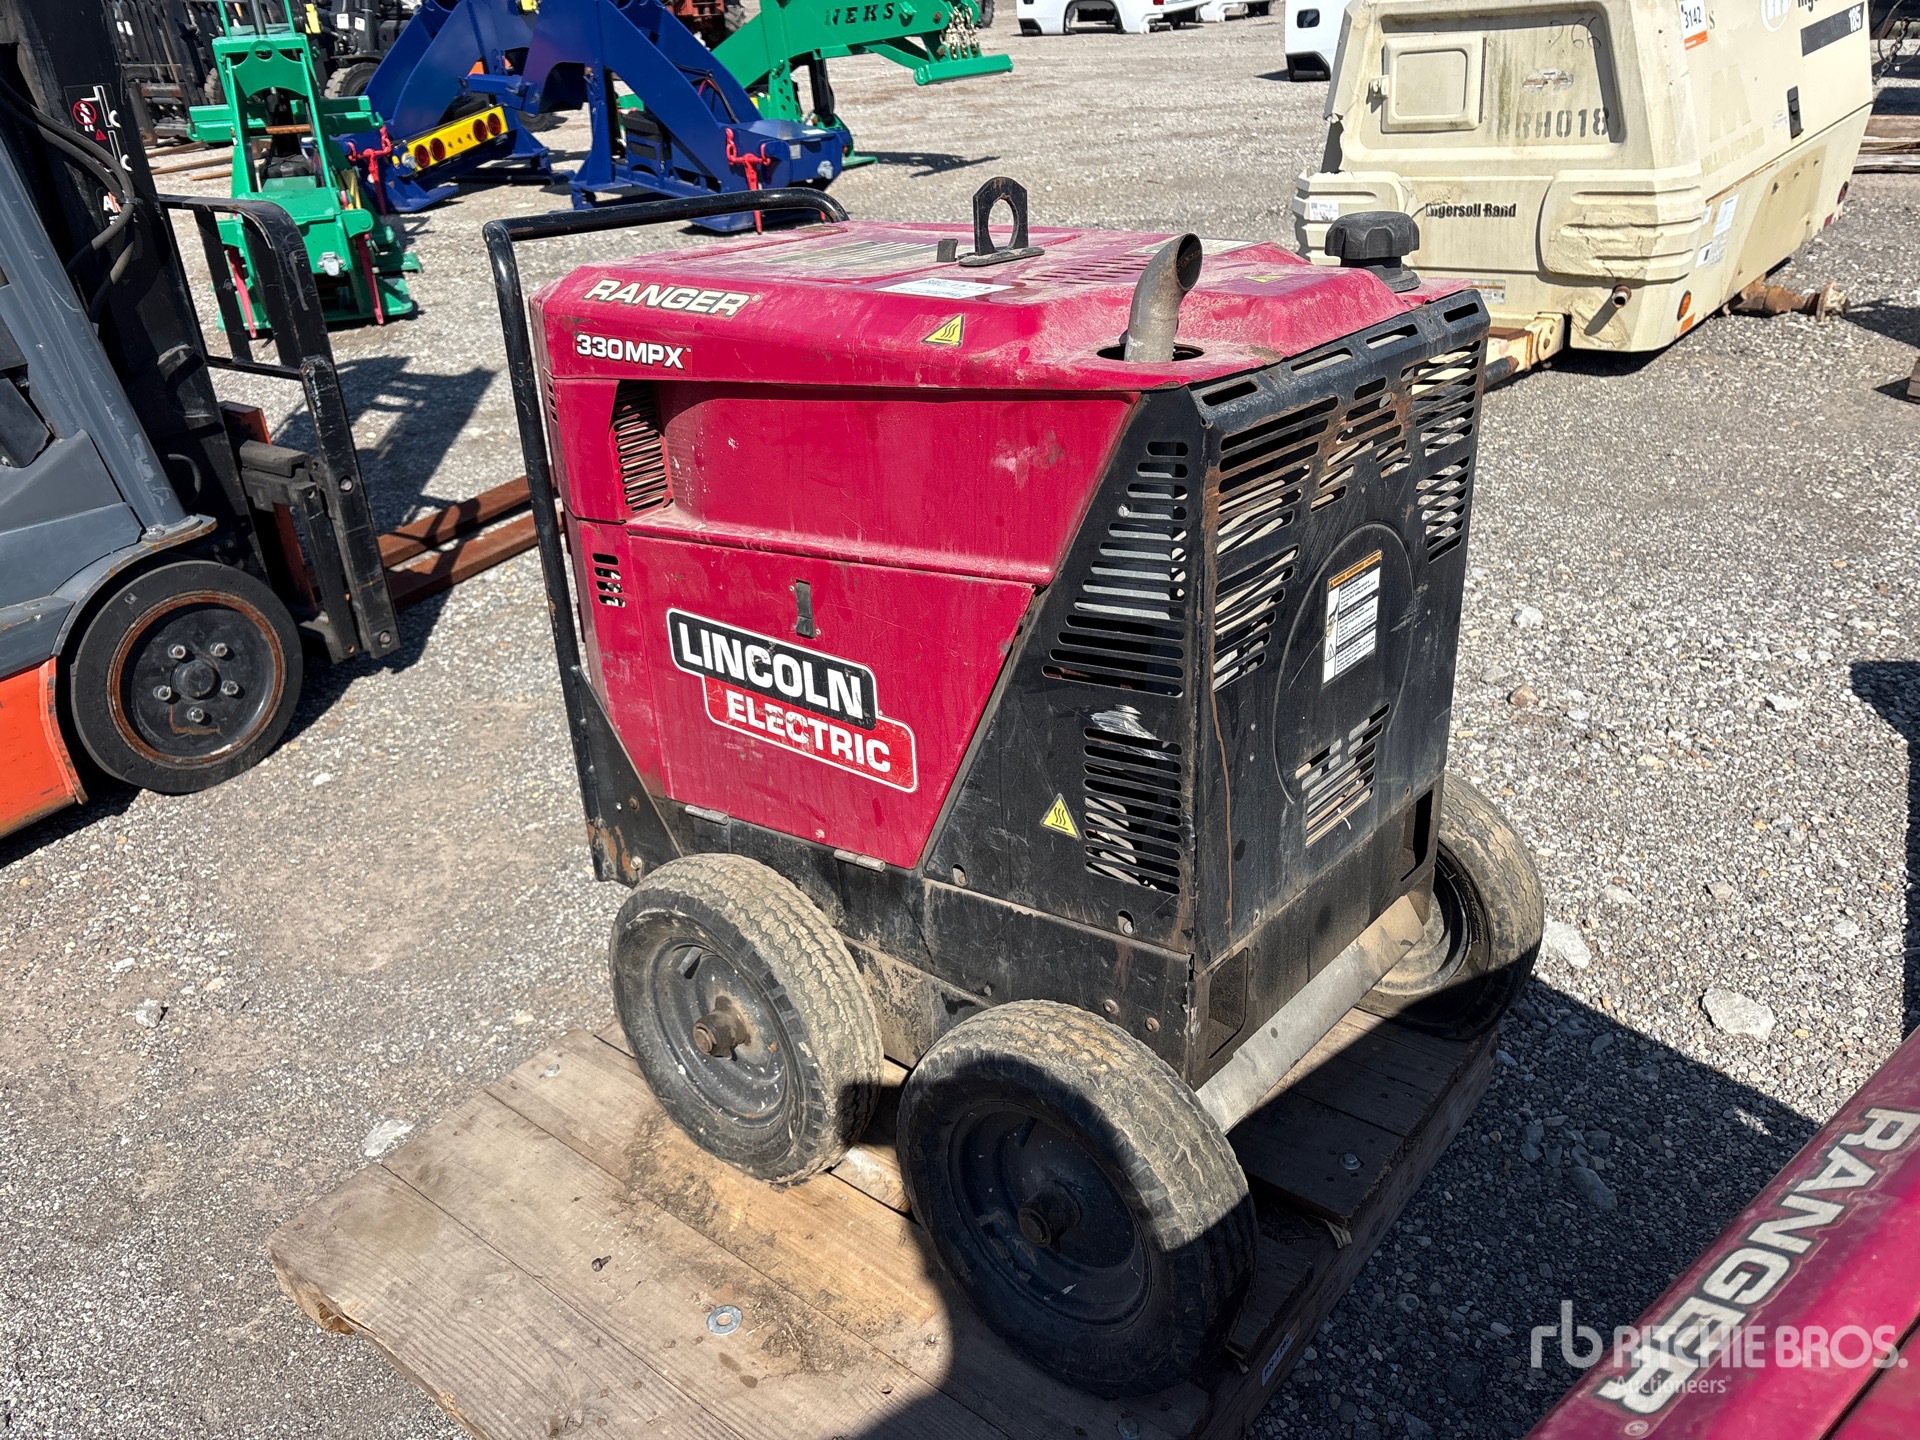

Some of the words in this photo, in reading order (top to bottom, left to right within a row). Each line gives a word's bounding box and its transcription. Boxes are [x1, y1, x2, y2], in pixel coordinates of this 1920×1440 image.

[583, 278, 751, 317] RANGER
[576, 334, 685, 370] 330MPX
[677, 622, 864, 720] LINCOLN
[725, 689, 892, 774] ELECTRIC
[1596, 1107, 1920, 1416] RANGER
